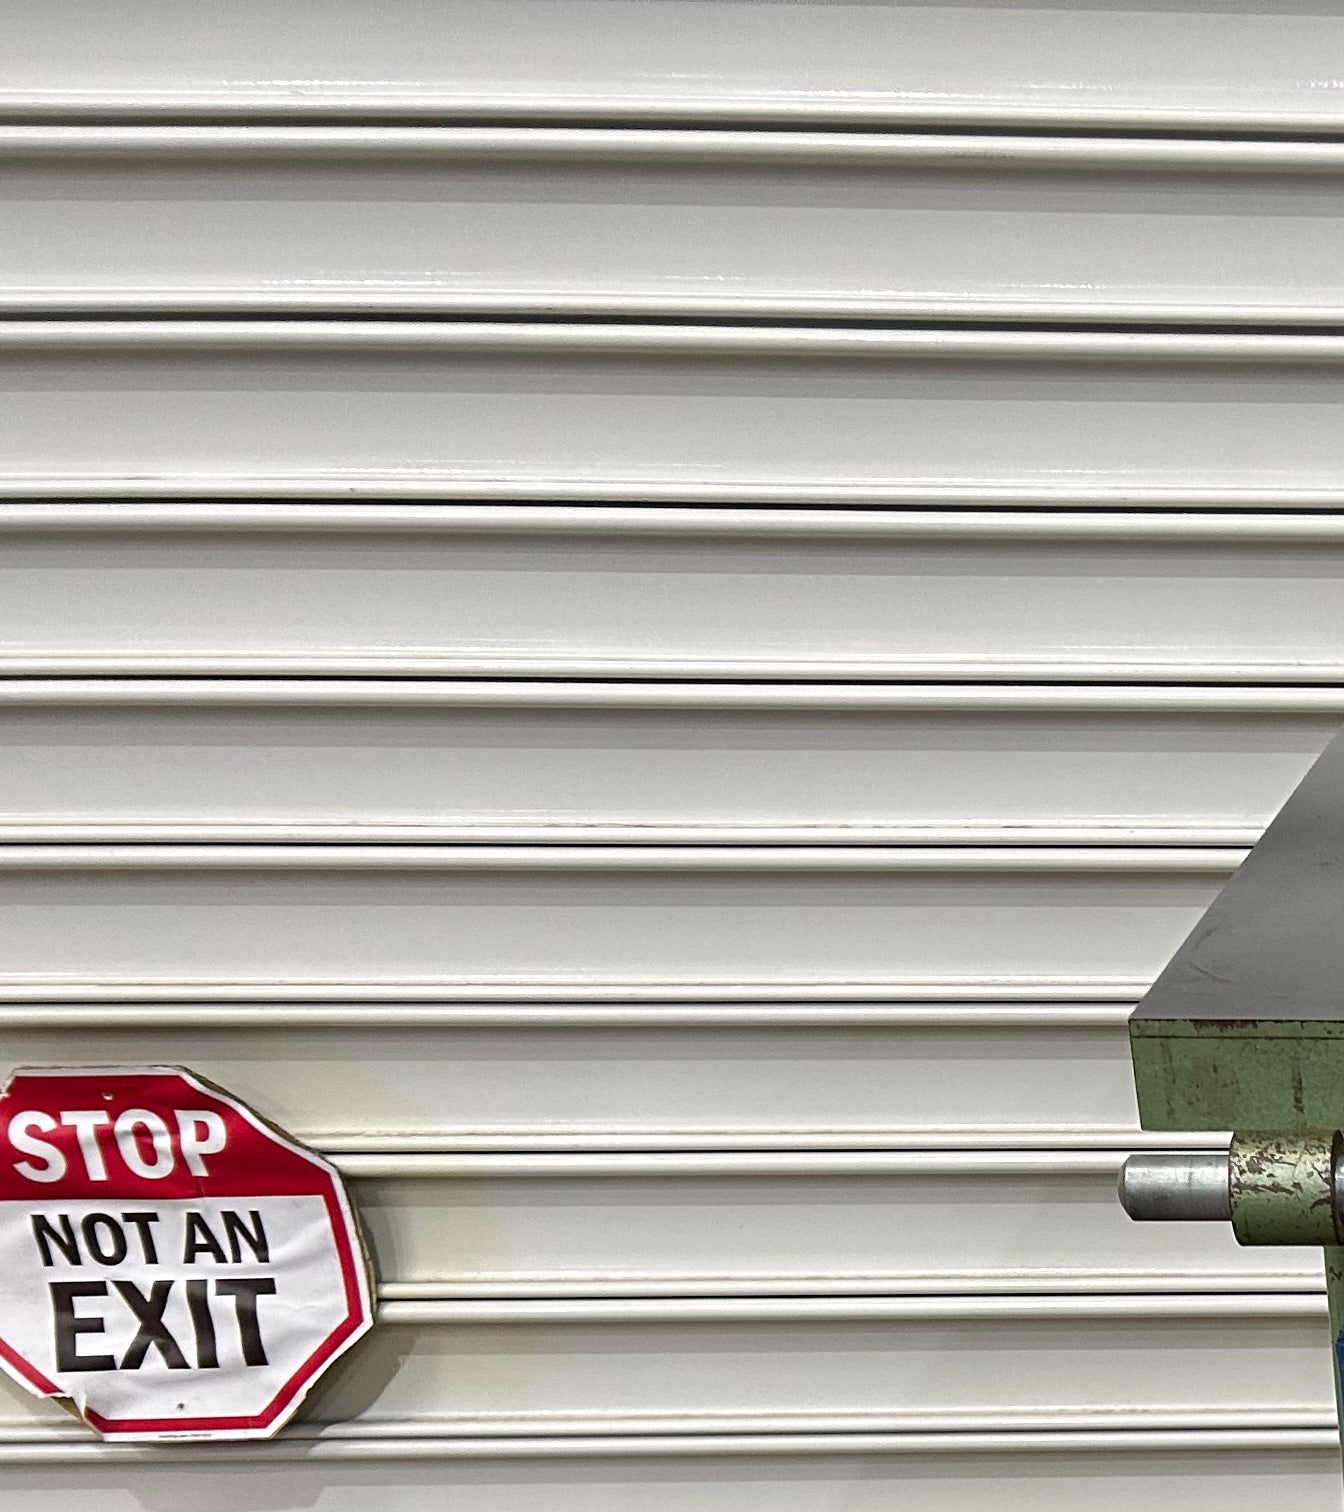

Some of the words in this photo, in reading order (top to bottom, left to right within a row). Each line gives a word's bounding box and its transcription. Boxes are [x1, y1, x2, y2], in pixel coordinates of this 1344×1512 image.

[7, 1107, 228, 1183] STOP
[31, 1212, 160, 1267] NOT
[183, 1210, 270, 1264] AN
[49, 1277, 277, 1373] EXIT
